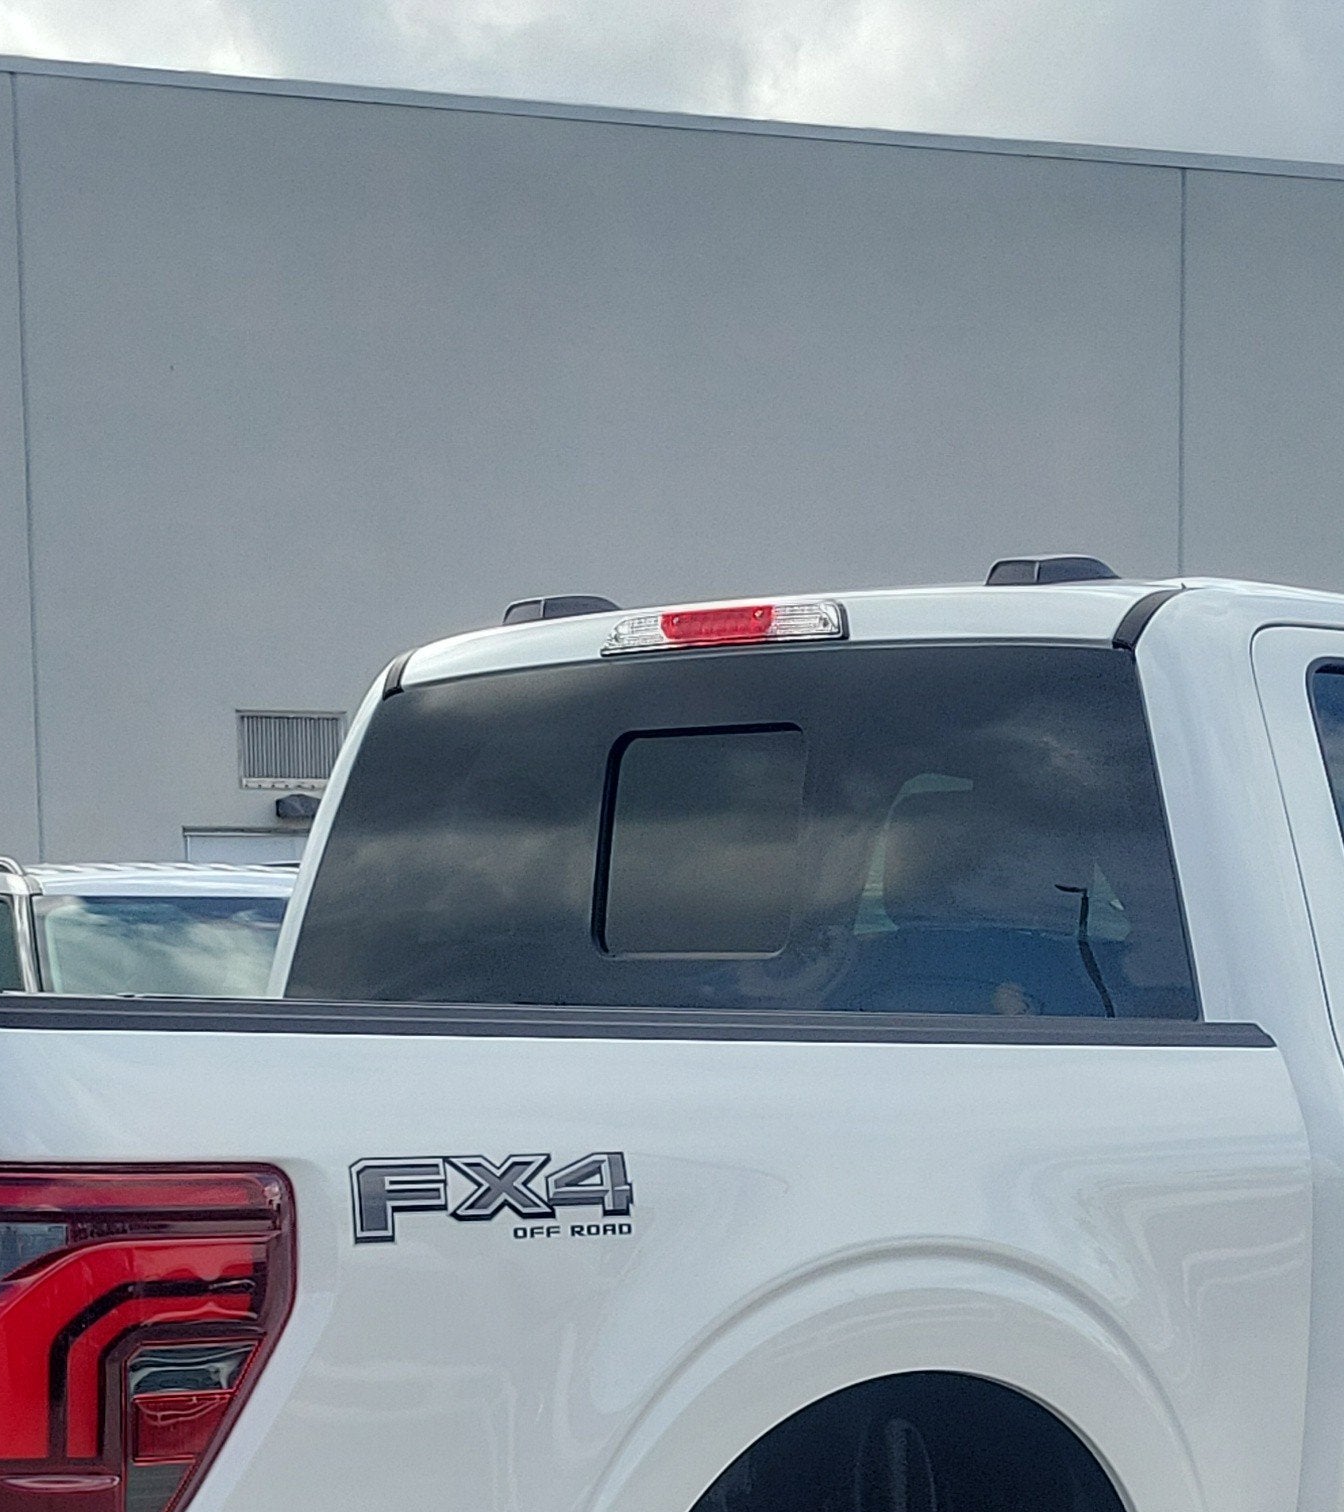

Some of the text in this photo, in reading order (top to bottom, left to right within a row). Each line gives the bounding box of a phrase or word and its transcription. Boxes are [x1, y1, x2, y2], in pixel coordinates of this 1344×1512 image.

[349, 1151, 633, 1245] FX4
[513, 1223, 632, 1240] OFF ROAD
